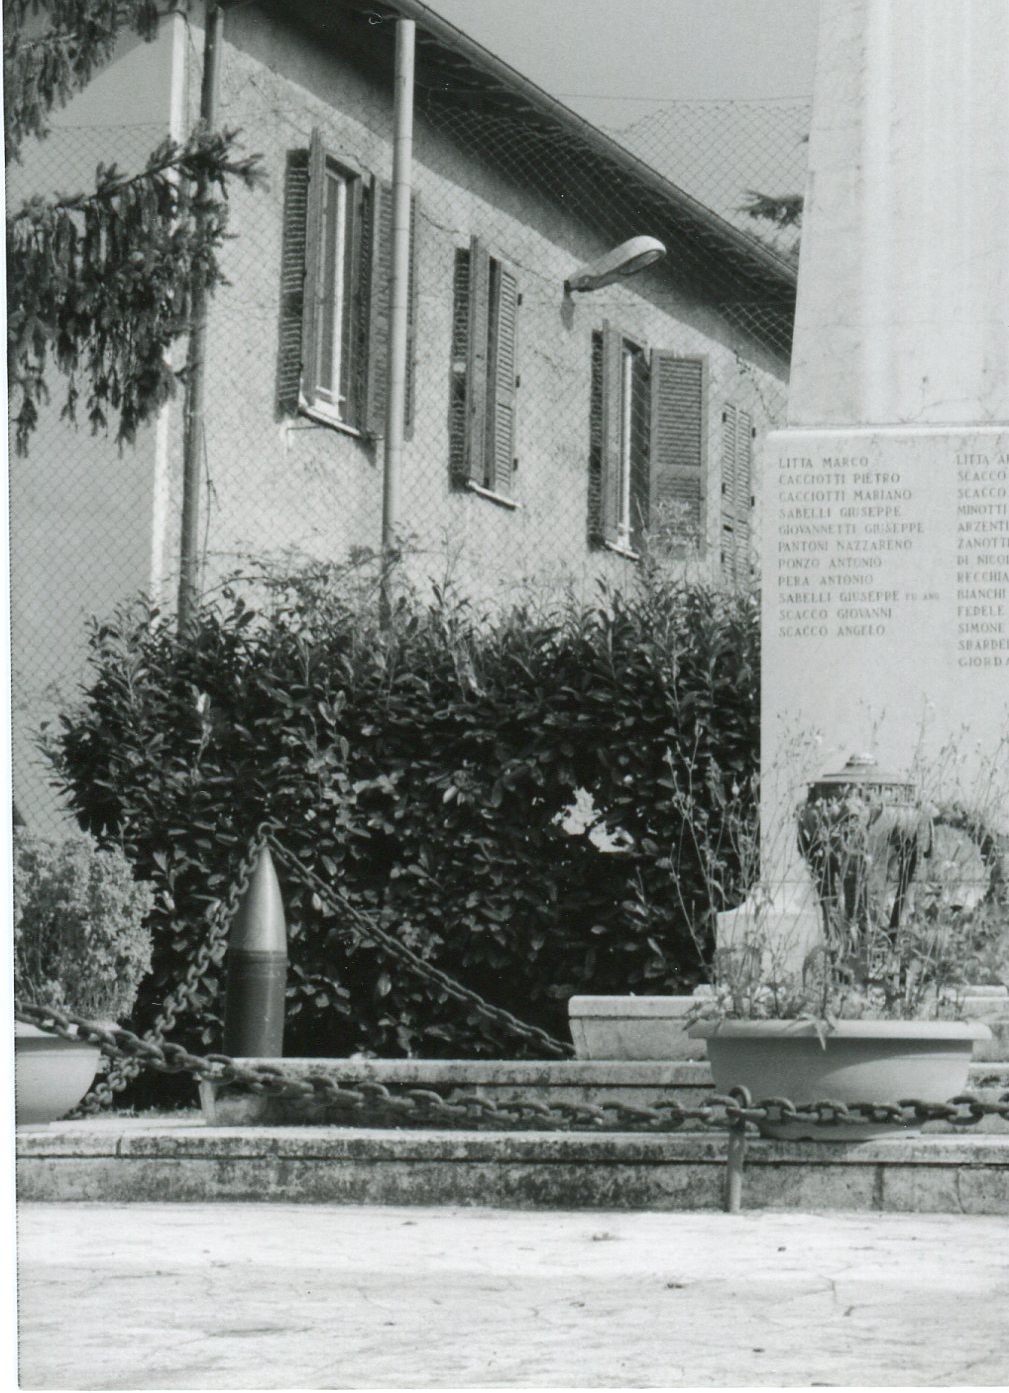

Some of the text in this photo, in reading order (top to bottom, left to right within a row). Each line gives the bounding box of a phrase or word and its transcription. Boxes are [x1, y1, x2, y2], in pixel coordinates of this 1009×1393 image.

[778, 457, 869, 469] LITTA MARCO
[956, 454, 990, 466] LITTA
[778, 473, 901, 485] CACCIOTTI PIETRO
[957, 470, 1007, 482] SCACCO
[778, 489, 913, 502] CACCIOTTI MARIANO
[957, 486, 1007, 499] SCACCO
[778, 506, 902, 519] SABELLI GIUSEPPE
[957, 503, 1007, 515] MINOTTI
[778, 522, 925, 535] GIOVANNETTI GIUSEPPE
[778, 539, 913, 553] PANTONI NAZZARENO
[778, 557, 883, 570] PONZO ANTONIO
[957, 555, 969, 566] DI
[778, 574, 874, 587] PERA ANTONIO
[957, 571, 1009, 583] RECCHIA
[778, 592, 832, 604] SABELLI
[839, 591, 900, 603] GIUSEPPE
[957, 588, 1006, 600] BIANCHI
[778, 607, 892, 621] SCACCO GIOVANNI
[957, 605, 1005, 617] FEDELE
[778, 624, 886, 638] SCACCO ANGELO
[958, 622, 1005, 634] SIMONE
